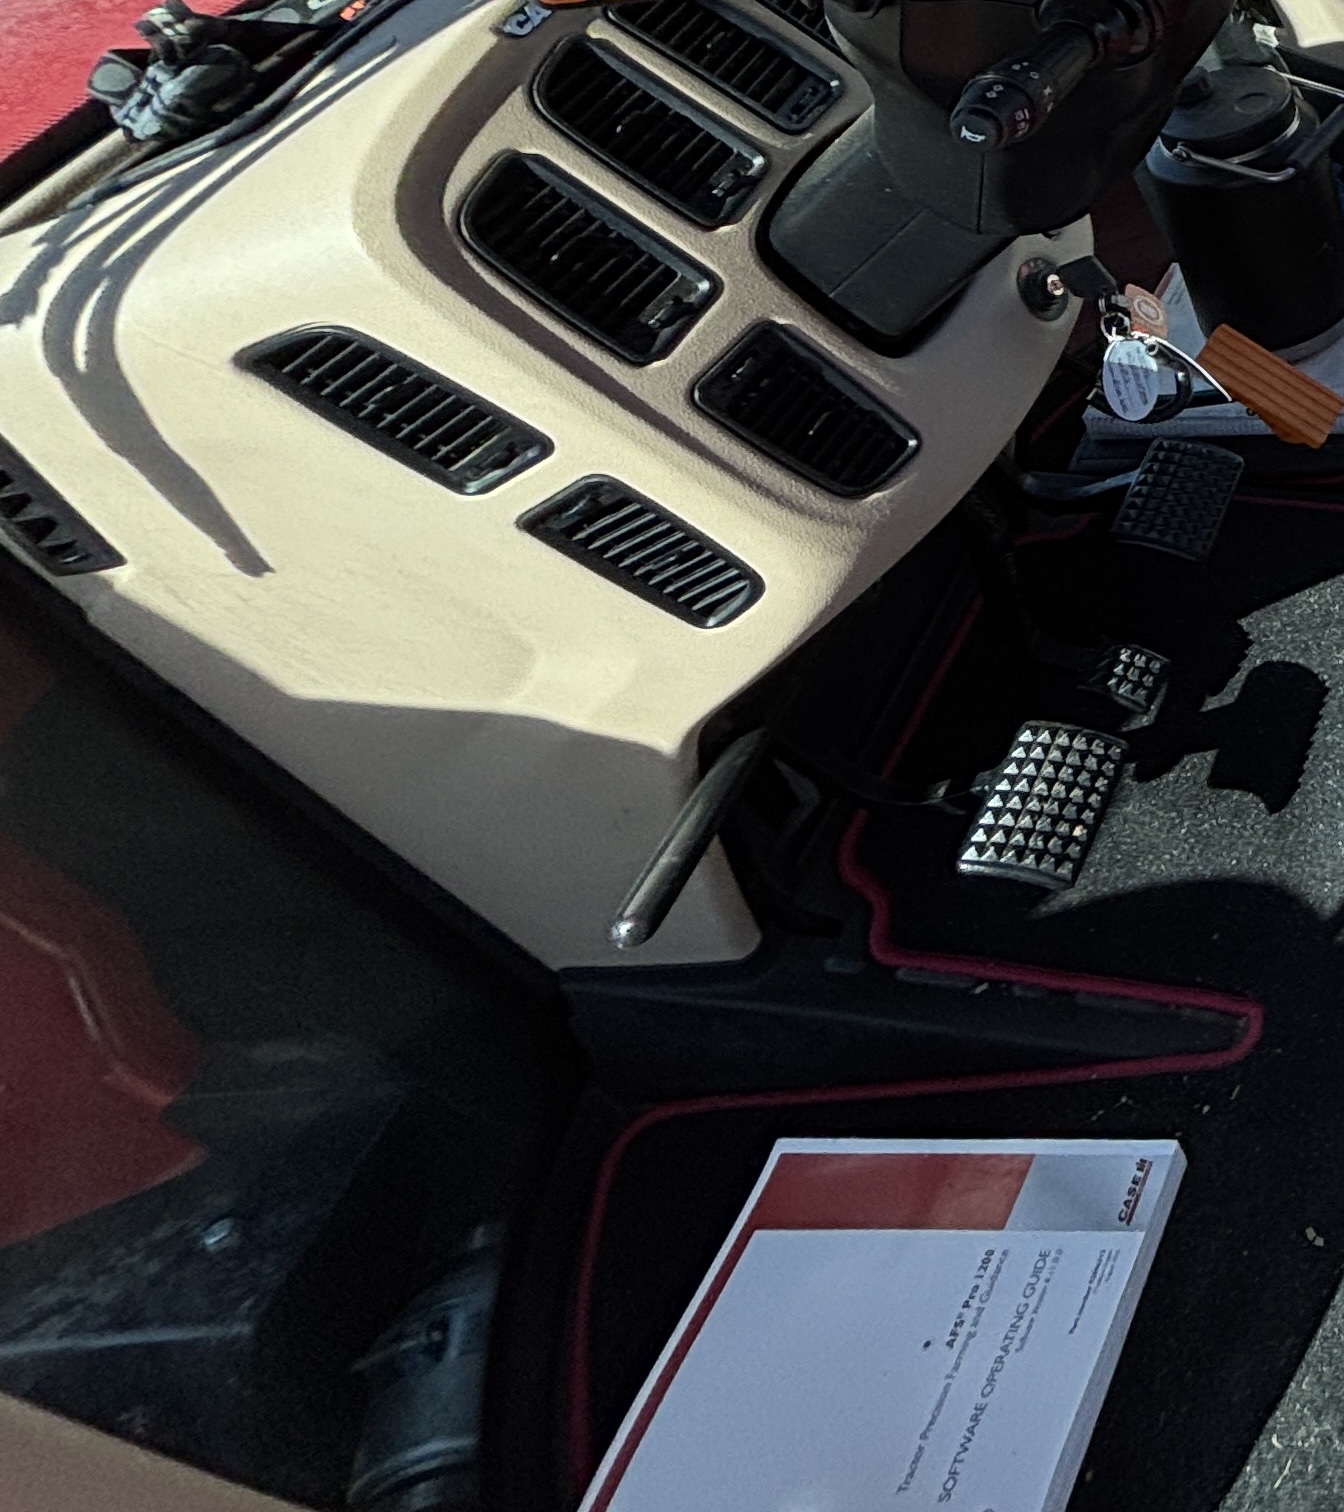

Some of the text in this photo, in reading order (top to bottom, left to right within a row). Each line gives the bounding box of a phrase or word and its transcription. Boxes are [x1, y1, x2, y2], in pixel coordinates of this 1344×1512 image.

[1118, 1173, 1142, 1223] CASE
[962, 1285, 980, 1309] Pro
[974, 1249, 995, 1279] 1200
[937, 1248, 1052, 1504] SOFTWARE OPERATING GUIDE
[896, 1445, 924, 1494] Tractor
